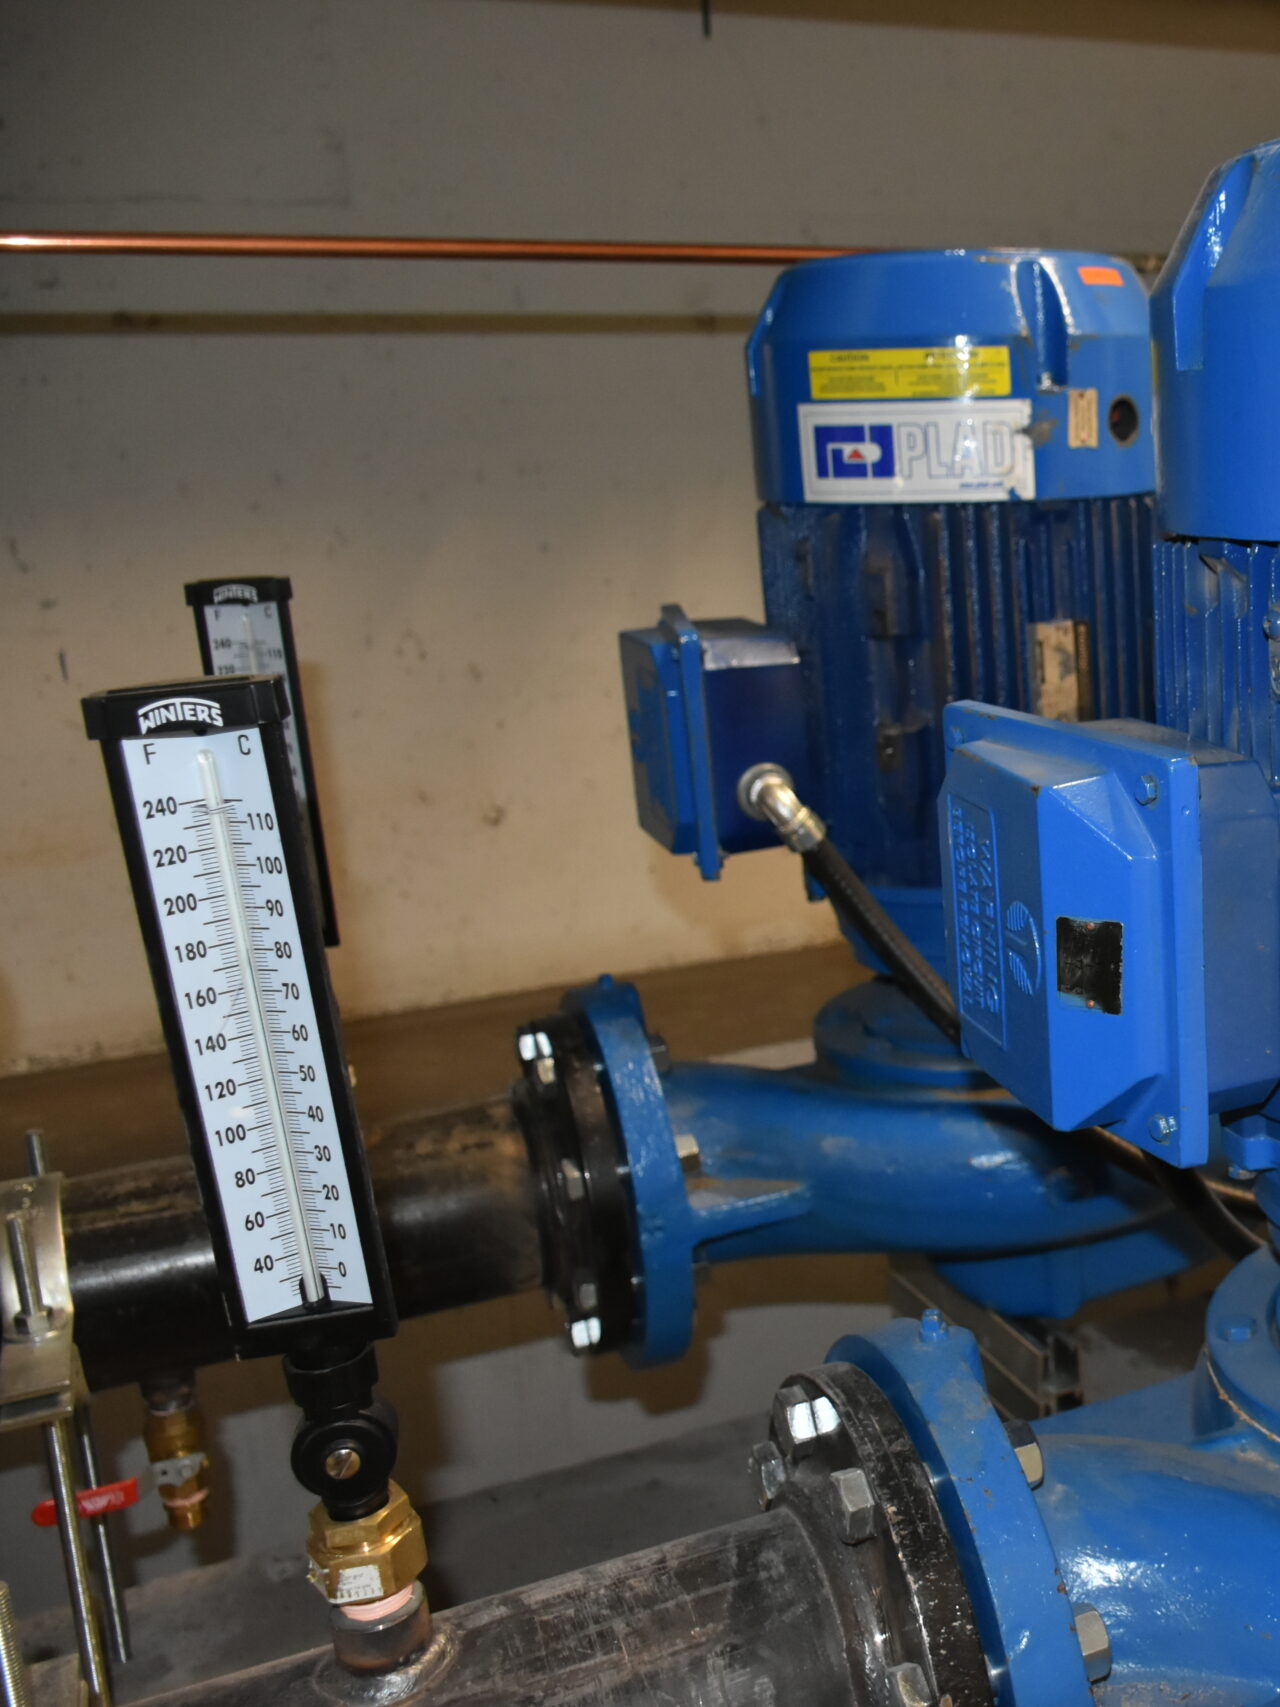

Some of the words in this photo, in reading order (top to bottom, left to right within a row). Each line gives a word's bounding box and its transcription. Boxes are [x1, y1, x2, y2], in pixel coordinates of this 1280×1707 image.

[896, 420, 1015, 479] PLAD
[138, 697, 224, 735] WINTERS
[142, 743, 157, 765] F
[237, 734, 252, 756] C
[142, 796, 178, 820] 240
[247, 812, 274, 831] 110
[153, 844, 187, 868] 220
[256, 856, 283, 875] 100
[163, 893, 198, 917] 200
[265, 899, 284, 917] 90
[174, 941, 207, 963] 180
[273, 941, 292, 960] 80
[184, 987, 217, 1010] 160
[282, 983, 300, 1001] 70
[291, 1024, 309, 1042] 60
[194, 1033, 226, 1056] 140
[298, 1065, 316, 1082] 50
[204, 1078, 237, 1102] 120
[307, 1106, 324, 1122] 40
[215, 1123, 247, 1147] 100
[314, 1146, 332, 1163] 30
[234, 1168, 256, 1189] 80
[322, 1184, 339, 1201] 20
[244, 1211, 265, 1232] 60
[329, 1223, 347, 1240] 10
[253, 1254, 274, 1274] 40
[338, 1261, 347, 1278] 0
